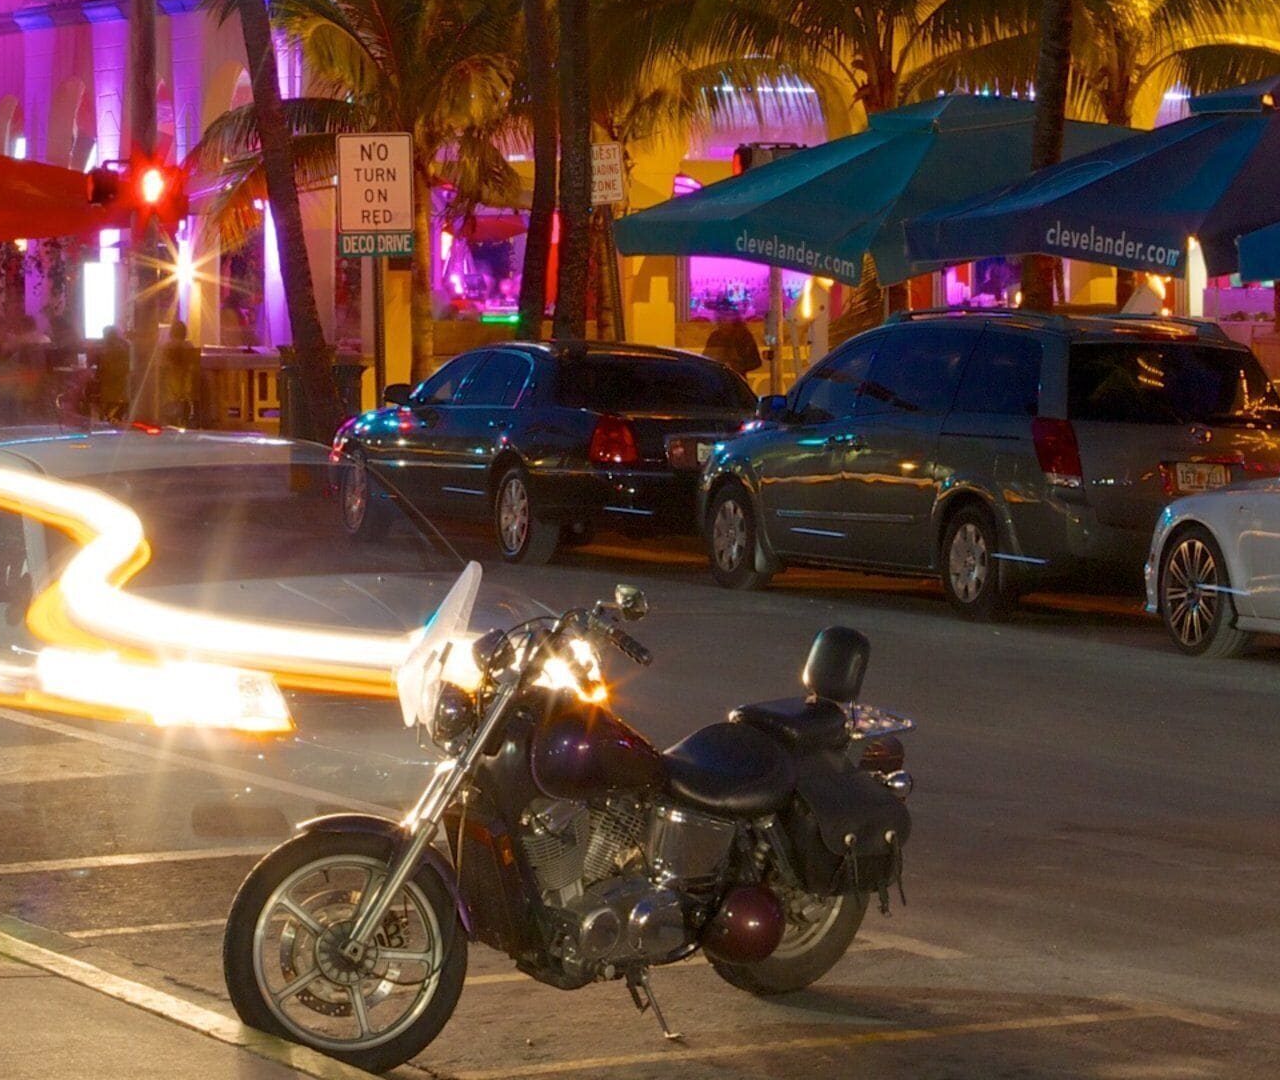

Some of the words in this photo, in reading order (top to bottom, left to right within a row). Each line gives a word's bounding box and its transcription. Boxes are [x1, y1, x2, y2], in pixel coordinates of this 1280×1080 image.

[360, 143, 388, 161] NO
[592, 146, 617, 160] UEST
[354, 168, 397, 182] TURN
[592, 164, 619, 176] ADING
[591, 180, 617, 192] ZONE
[364, 189, 388, 203] ON
[361, 210, 392, 224] RED
[343, 235, 375, 254] DECO
[377, 234, 412, 253] DRIVE
[1046, 220, 1180, 267] clevelander.com
[735, 229, 855, 278] clevelander.com
